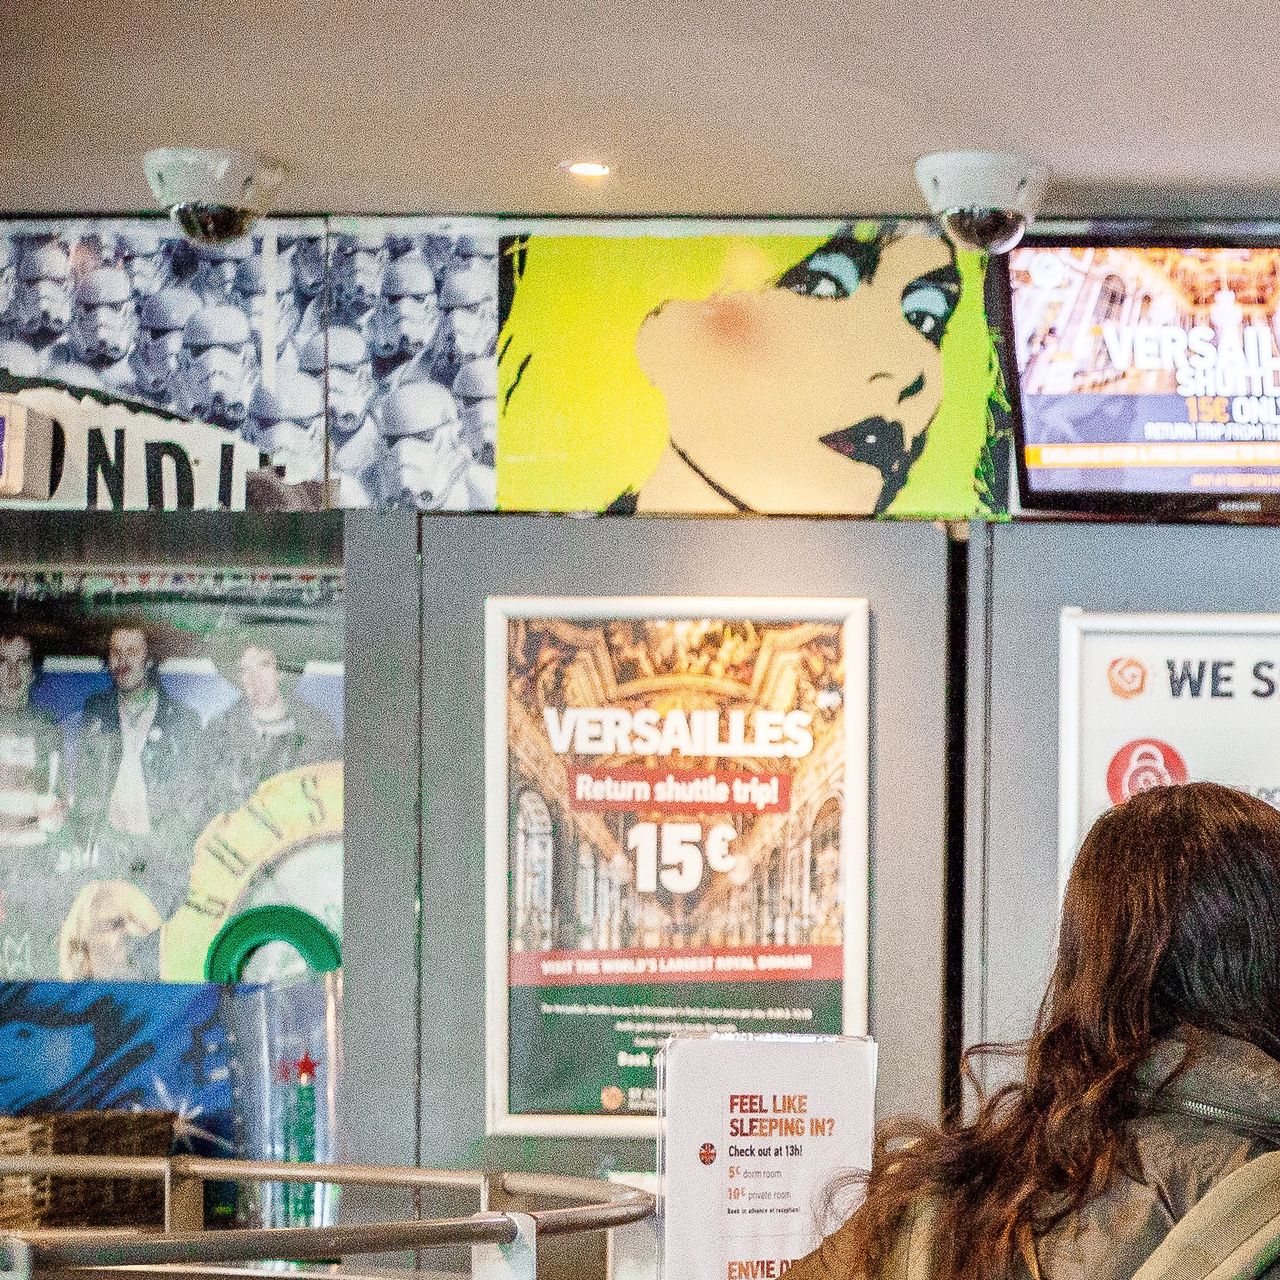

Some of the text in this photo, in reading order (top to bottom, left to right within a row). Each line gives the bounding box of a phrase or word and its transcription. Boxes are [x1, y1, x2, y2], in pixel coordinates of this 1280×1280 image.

[1167, 658, 1234, 699] WE
[542, 707, 814, 759] VERSAILLES
[576, 773, 650, 803] Return
[653, 773, 729, 804] shuttle
[626, 822, 738, 895] 15€
[729, 1094, 808, 1114] FEEL LIKE
[729, 1118, 836, 1137] SLEEPING IN?
[728, 1145, 803, 1157] Check out at 13h!
[742, 1169, 761, 1179] dorm
[762, 1170, 782, 1179] room
[773, 1190, 792, 1200] room
[727, 1259, 776, 1280] ENVIE
